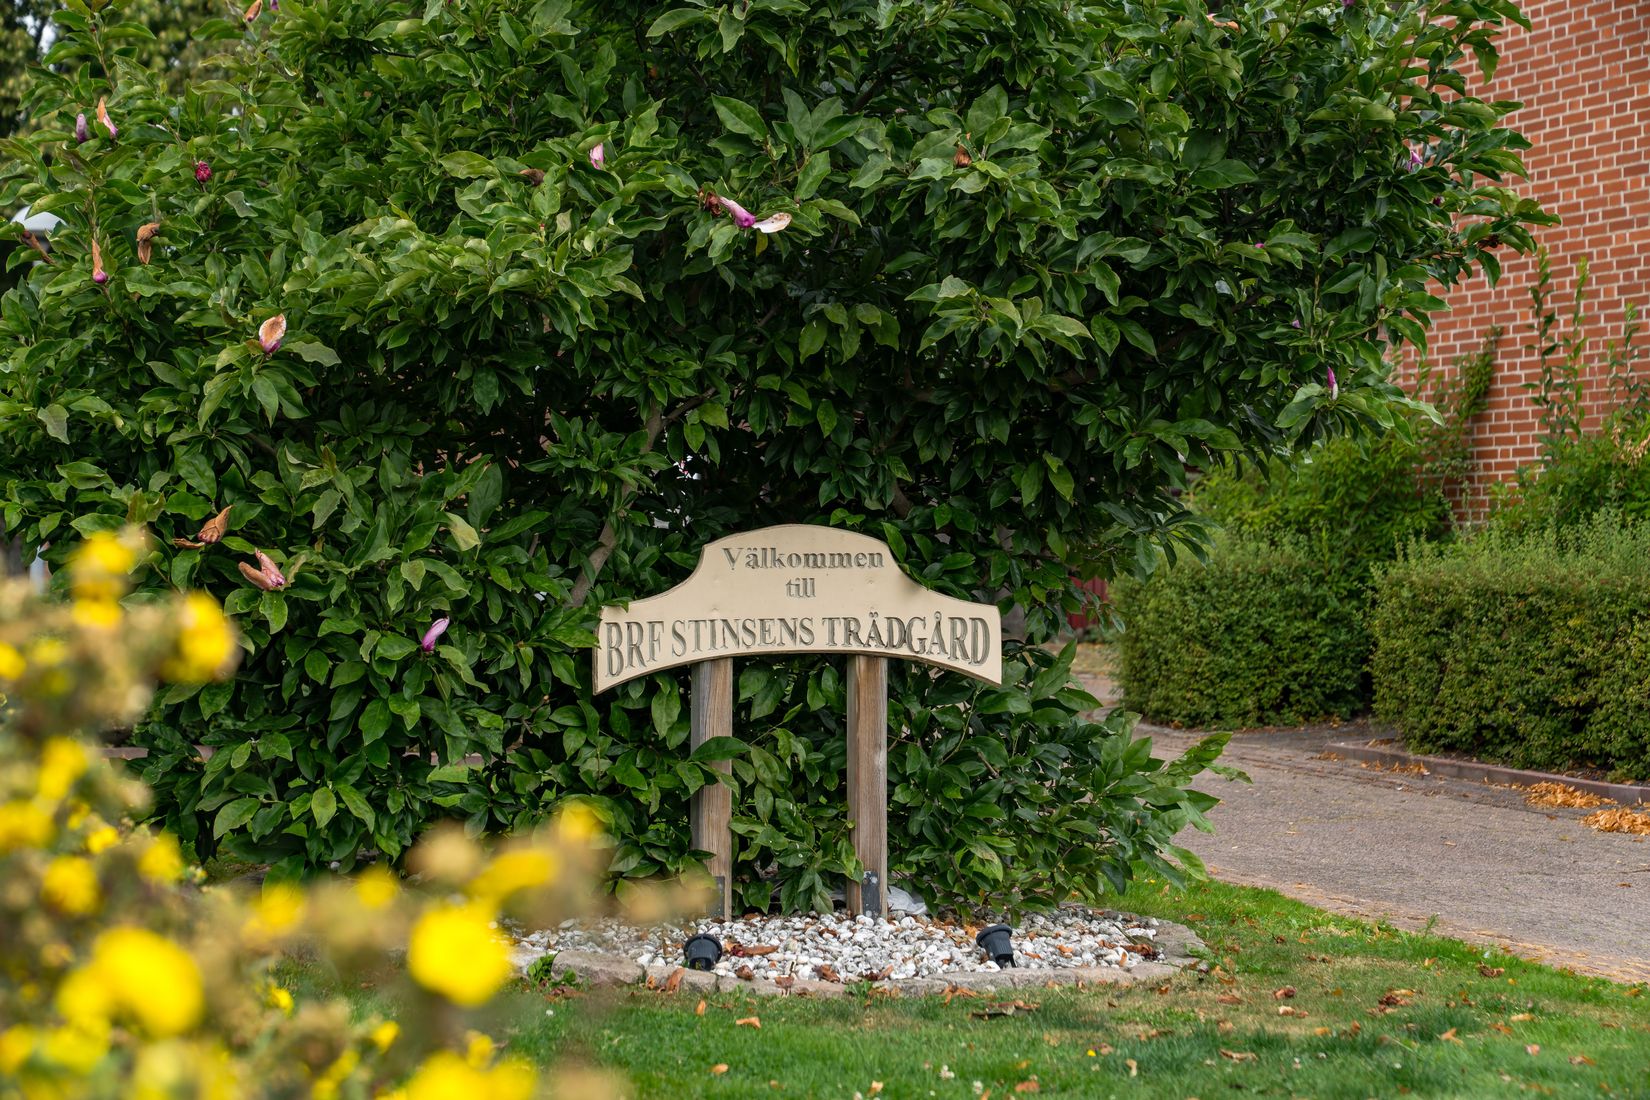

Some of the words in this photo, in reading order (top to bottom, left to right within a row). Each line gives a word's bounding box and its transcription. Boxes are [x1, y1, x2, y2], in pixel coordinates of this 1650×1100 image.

[722, 547, 885, 571] Välkommen
[785, 577, 816, 598] till
[605, 620, 665, 678] BRF
[671, 617, 816, 658] STINSENS
[822, 611, 991, 666] TRÄDGÅRD
